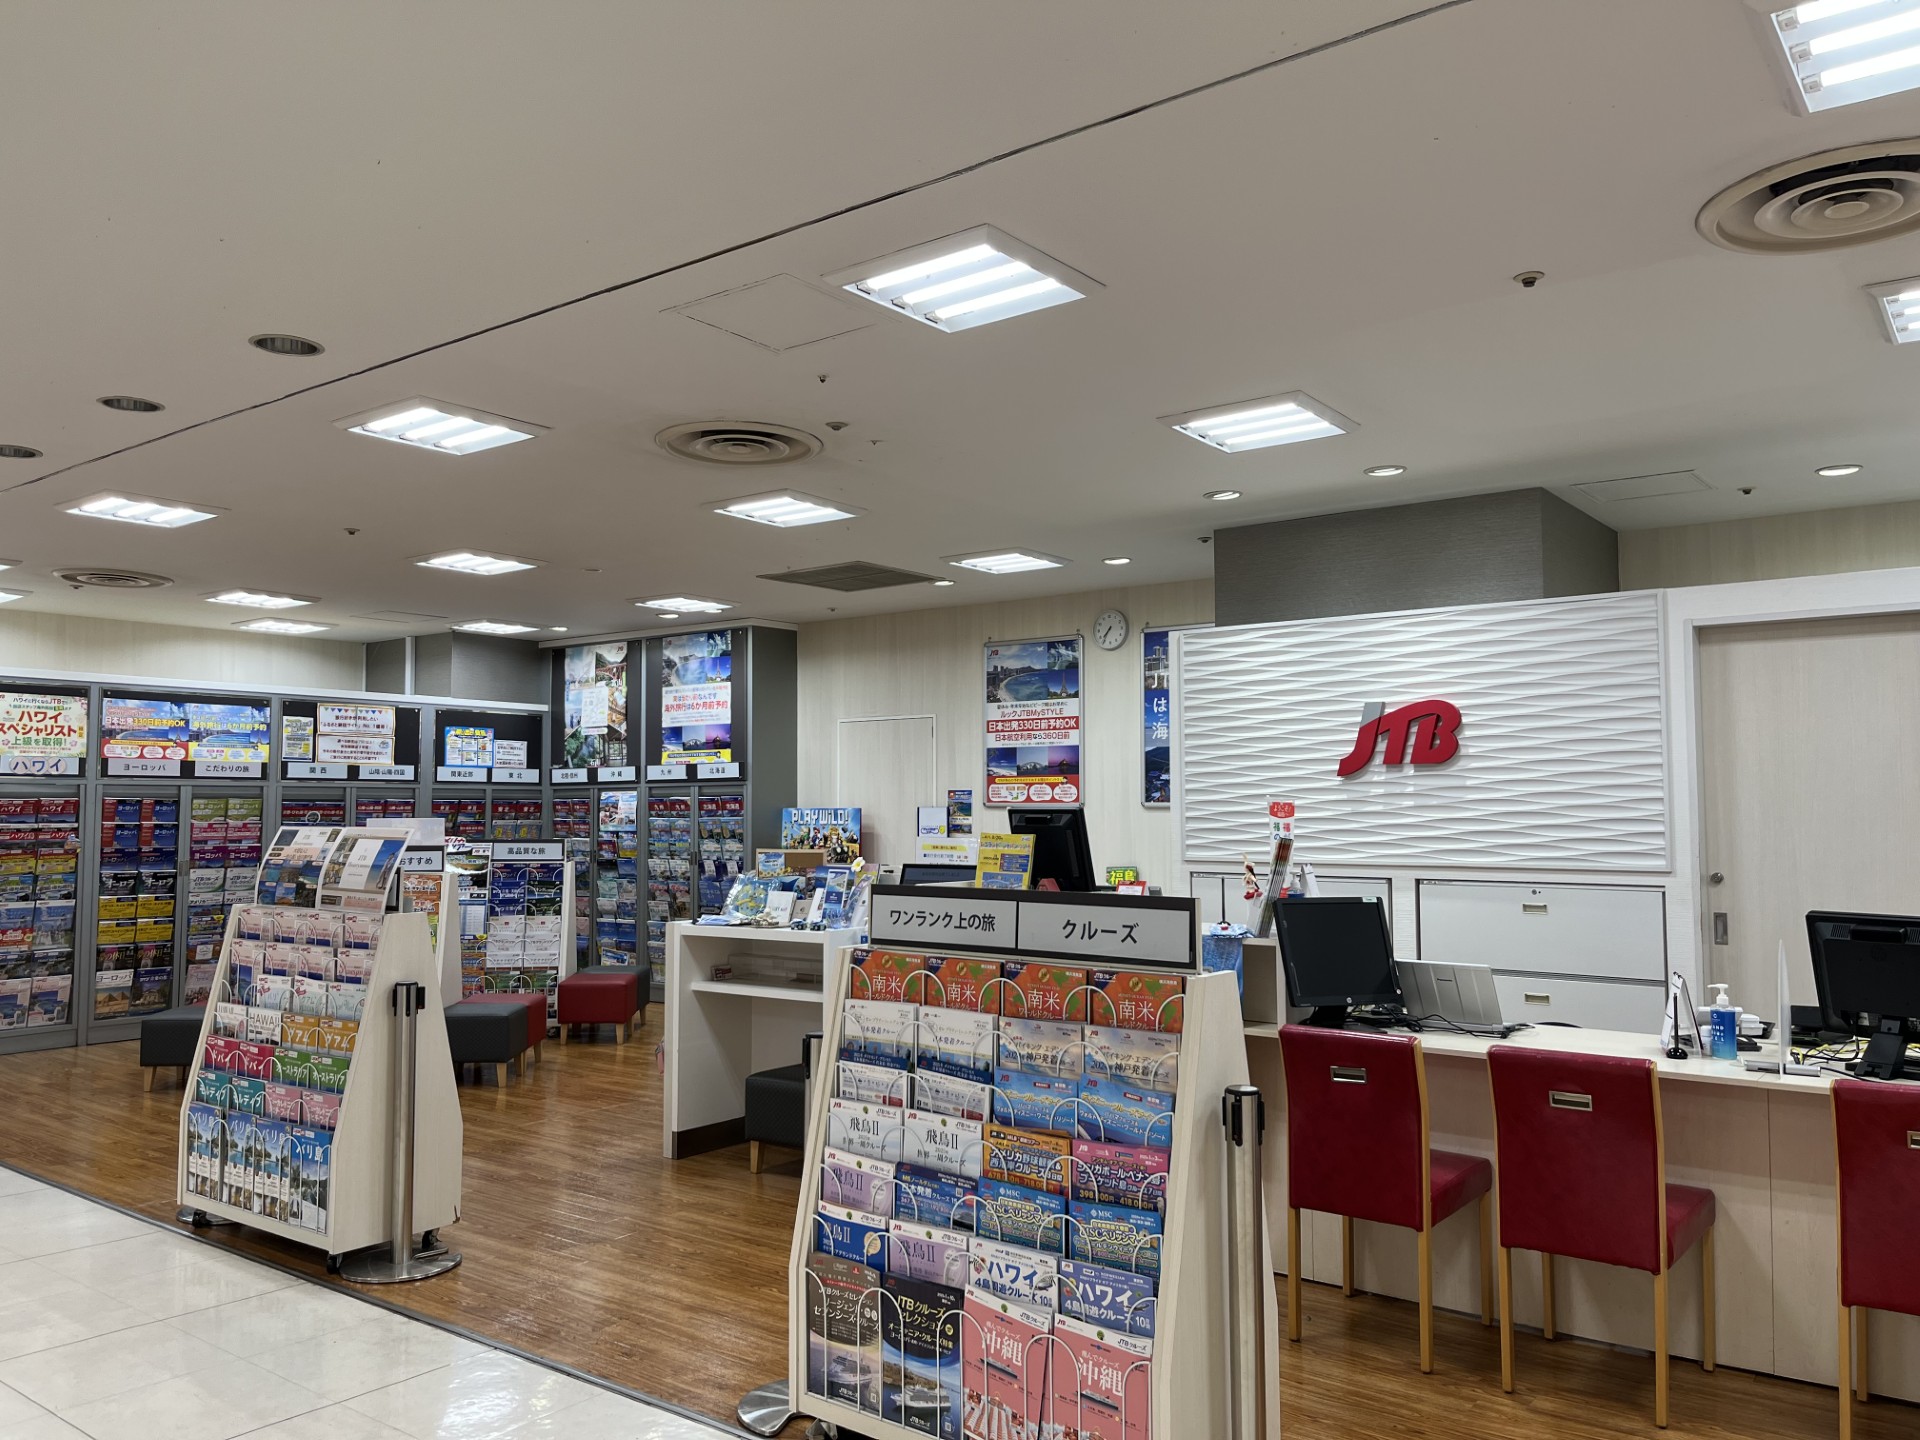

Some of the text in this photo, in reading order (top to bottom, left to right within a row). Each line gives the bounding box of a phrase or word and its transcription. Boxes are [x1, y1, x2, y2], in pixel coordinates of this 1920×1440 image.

[664, 701, 728, 713] 海外旅行は6か月前予約
[1001, 708, 1064, 718] ルックJTBMySTYLE
[18, 711, 63, 723] ハワイ
[105, 717, 186, 728] 日本出発330日前予約OK
[988, 718, 1076, 731] 日本出発330日前予約OK
[1152, 721, 1169, 740] 海
[995, 731, 1070, 741] 日本航空利用なら360日前
[1337, 700, 1462, 776] JTB
[13, 758, 61, 772] ハワイ
[205, 765, 250, 773] こだわりの旅
[709, 766, 726, 774] 北海道
[660, 768, 672, 776] 九州
[791, 809, 818, 825] PLAY
[507, 847, 546, 855] 高品質な旅
[400, 857, 433, 866] おすすめ
[105, 879, 135, 888] オーロラ
[144, 878, 174, 887] オーロラ
[1109, 869, 1137, 885] 福島
[889, 909, 996, 932] ワンランク上の旅
[1062, 919, 1140, 944] クルーズ
[1094, 972, 1117, 980] JTBクルーズ
[872, 974, 902, 993] 南米
[947, 983, 976, 1002] 南米
[1028, 989, 1060, 1010] 南米
[1119, 1000, 1154, 1021] 南米
[860, 1025, 898, 1036] 日本発着クルー
[313, 1071, 345, 1085] オーストラリア
[1086, 1078, 1098, 1087] JTB
[926, 1128, 958, 1150] 飛鳥II
[296, 1144, 323, 1162] バリ島
[1006, 1187, 1020, 1197] MSC
[1099, 1210, 1113, 1218] MSC
[988, 1260, 1038, 1289] ハワイ
[966, 1289, 974, 1297] JTB
[1079, 1281, 1132, 1311] ハワイ
[898, 1295, 946, 1318] JTBクルーズ
[1020, 1312, 1046, 1327] JTBクルーズ
[1057, 1318, 1067, 1326] JTB
[982, 1327, 1022, 1366] 沖縄
[1118, 1338, 1147, 1351] JTBクルーズ
[1078, 1357, 1123, 1397] 沖縄
